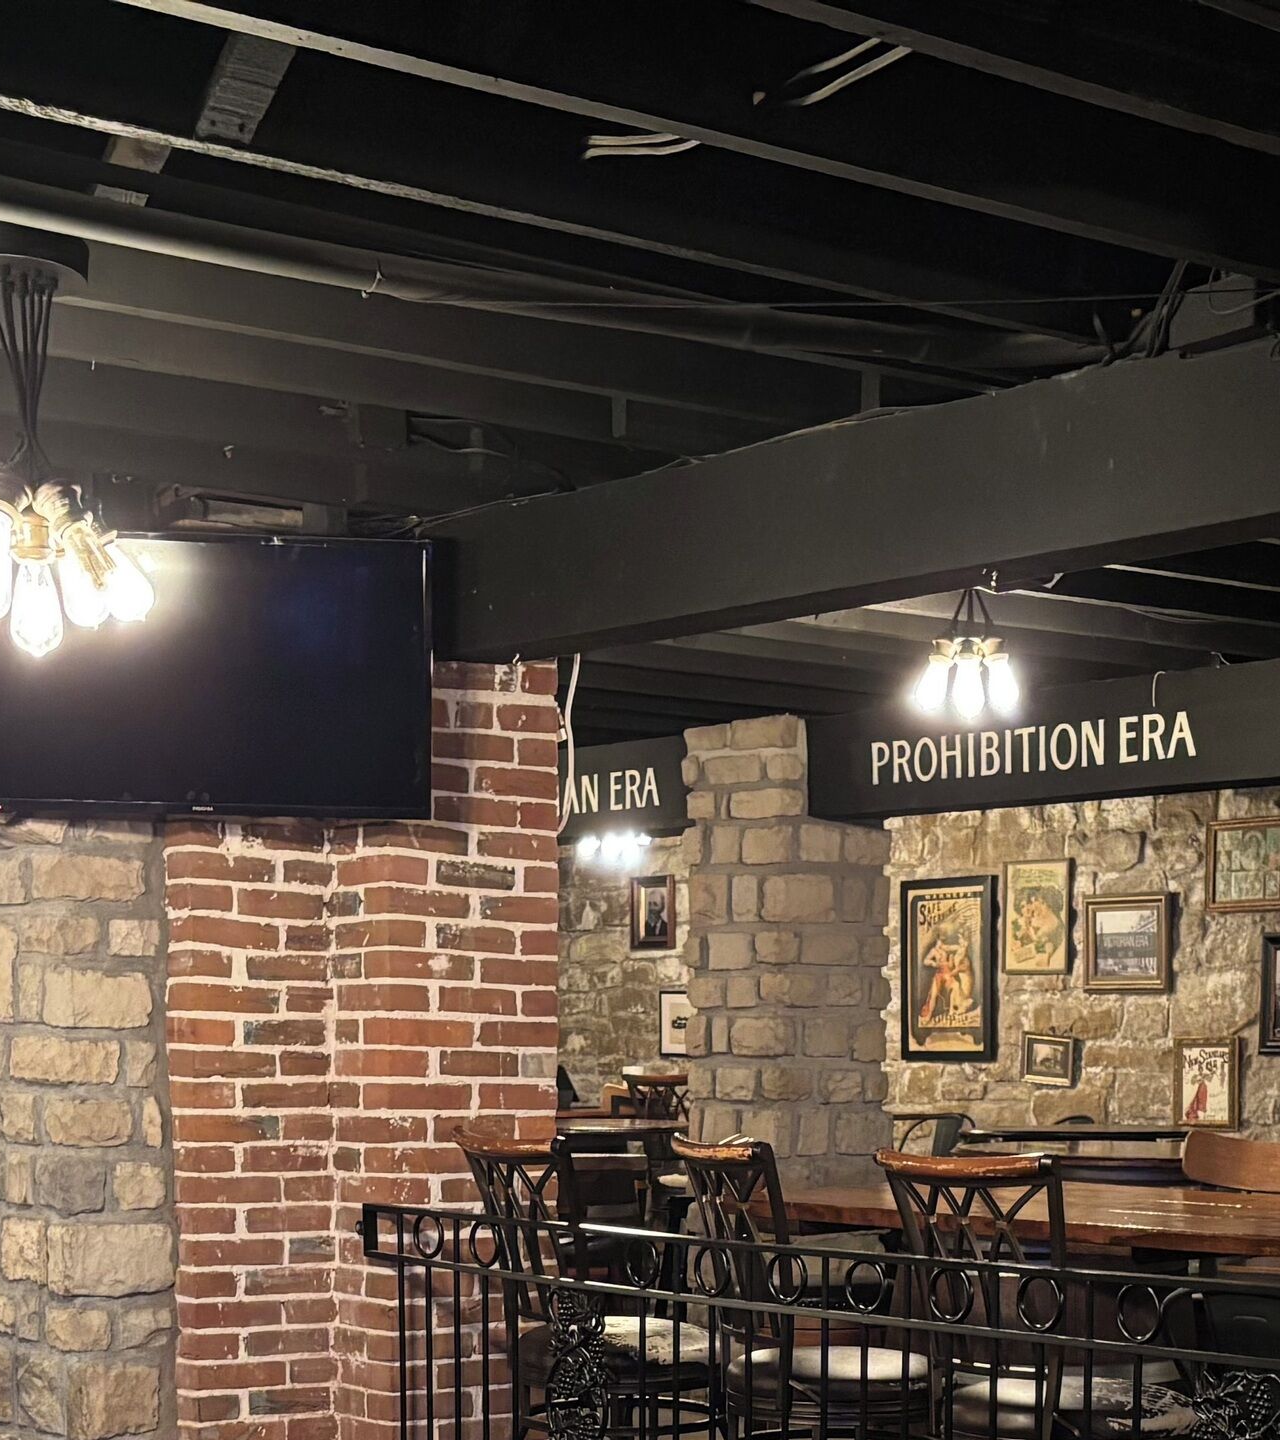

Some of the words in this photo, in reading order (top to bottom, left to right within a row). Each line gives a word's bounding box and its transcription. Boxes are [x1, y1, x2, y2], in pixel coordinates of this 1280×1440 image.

[871, 718, 1105, 786] PROHIBITION
[1119, 711, 1197, 763] ERA
[609, 767, 660, 811] ERA
